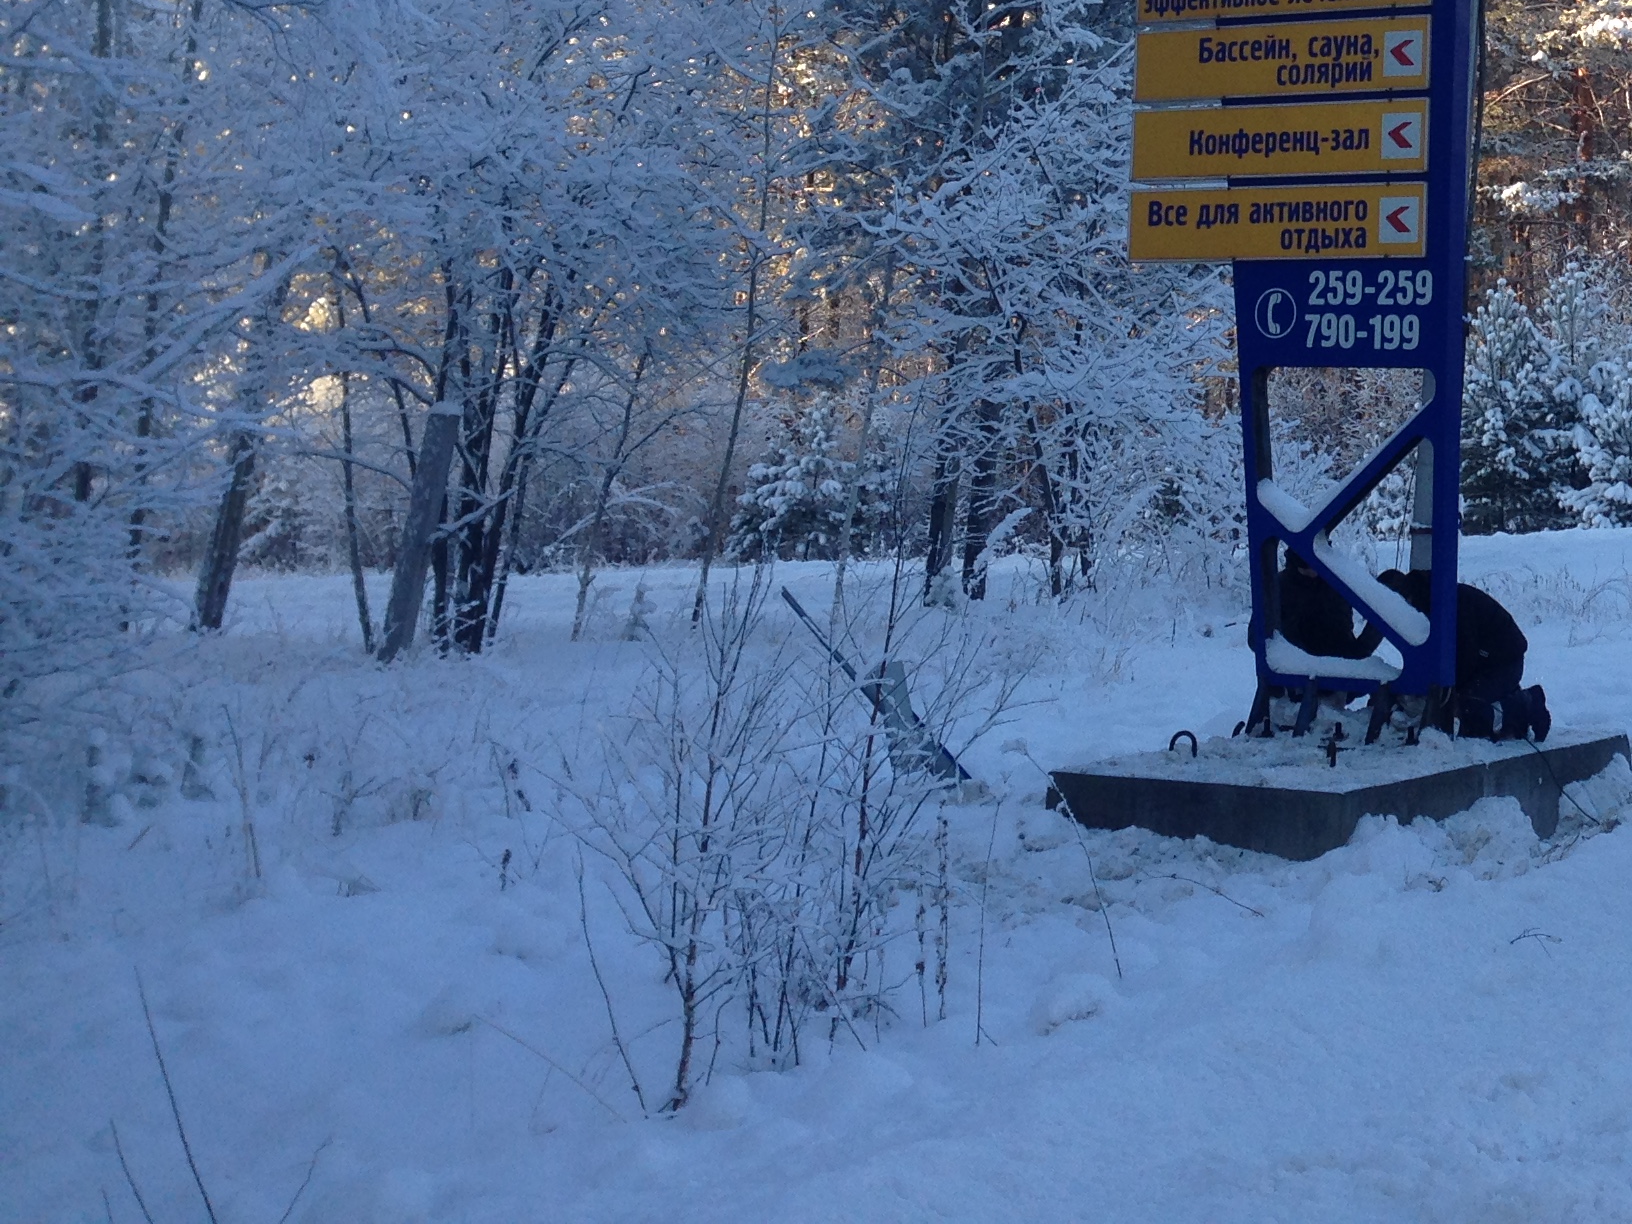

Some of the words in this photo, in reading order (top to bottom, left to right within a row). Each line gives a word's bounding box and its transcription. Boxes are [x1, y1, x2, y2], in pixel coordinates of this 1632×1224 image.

[1199, 34, 1298, 64] Бассейн,
[1308, 32, 1380, 64] сауна,
[1276, 56, 1373, 87] солярий
[1189, 126, 1370, 159] Конференц-зал
[1148, 200, 1188, 227] Все
[1196, 202, 1239, 228] для
[1249, 198, 1368, 225] активного
[1280, 225, 1366, 254] отдыха
[1308, 269, 1433, 306] 259-259
[1305, 313, 1420, 350] 790-199
